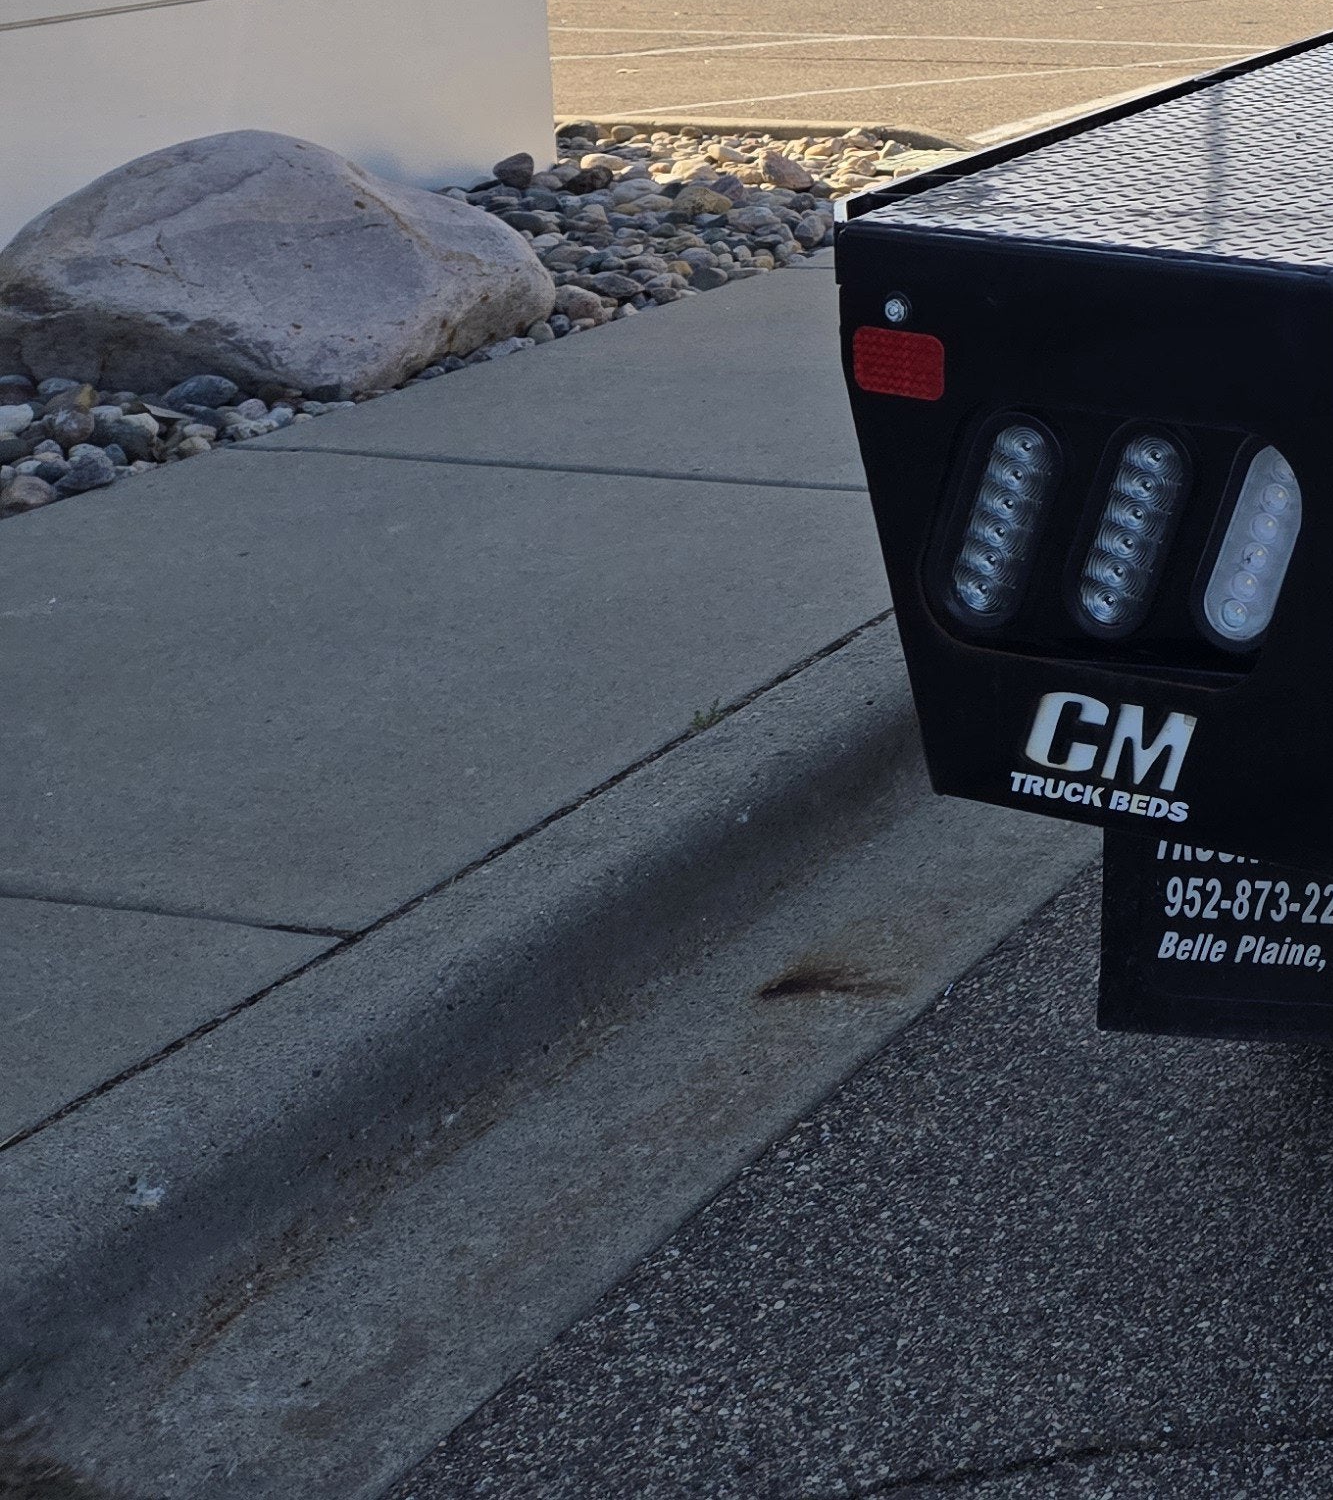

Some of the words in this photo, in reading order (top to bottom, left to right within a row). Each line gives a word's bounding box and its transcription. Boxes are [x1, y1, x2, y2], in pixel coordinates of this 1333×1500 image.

[1025, 691, 1198, 792] CM
[1010, 771, 1105, 808] TRUCK
[1108, 790, 1190, 823] BEDS
[1157, 931, 1225, 963] Belle
[1234, 935, 1327, 972] Plaine,
